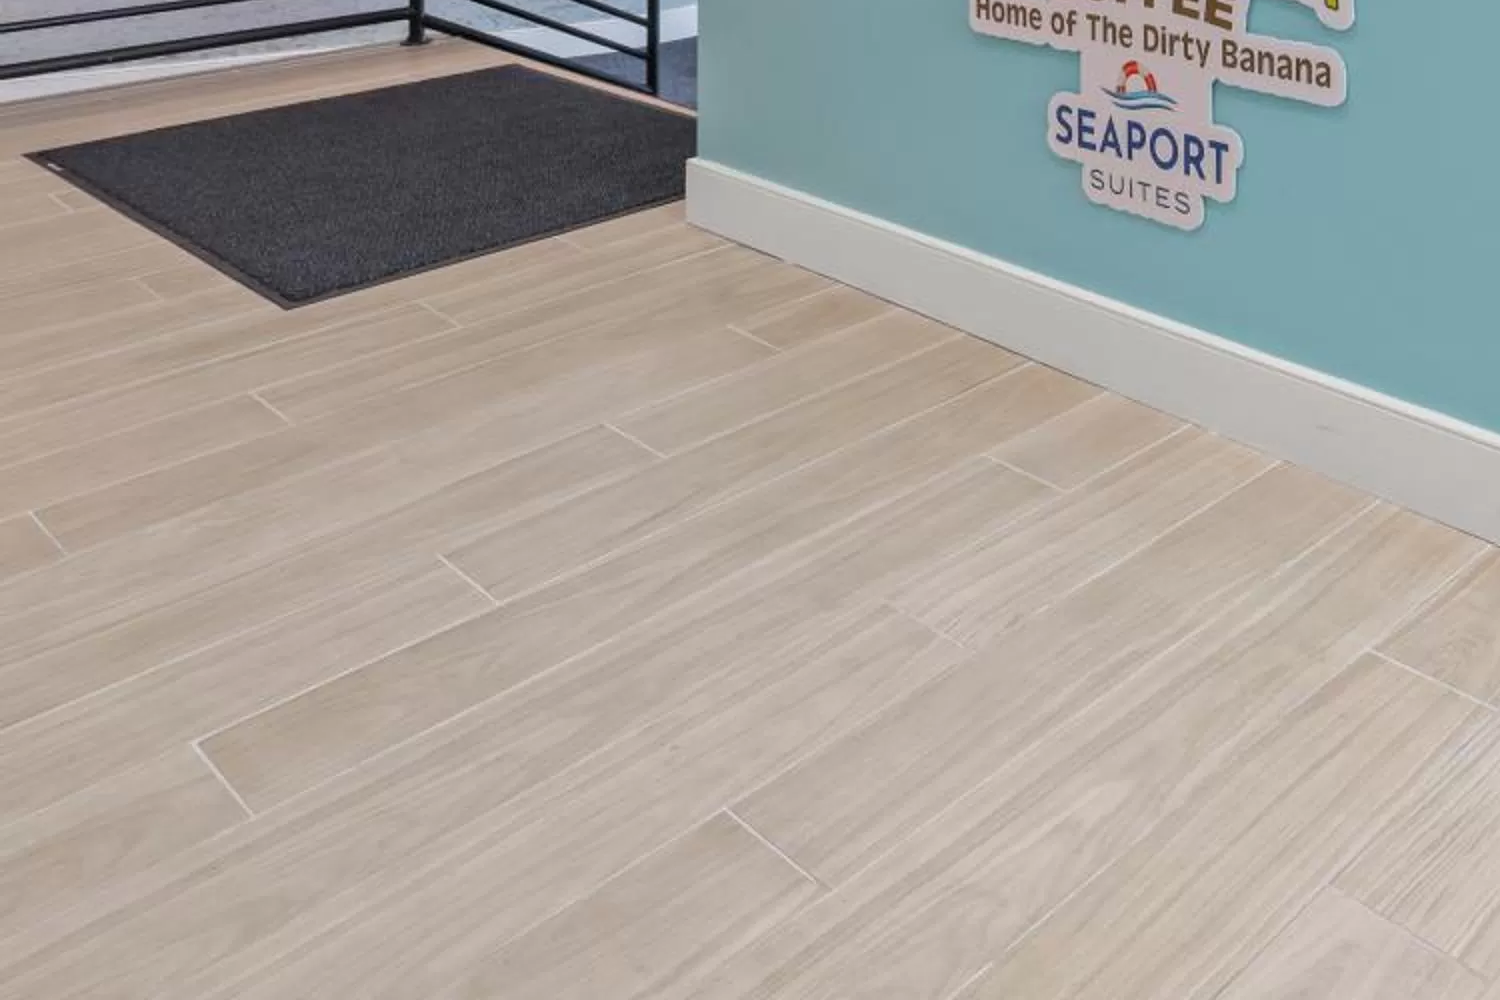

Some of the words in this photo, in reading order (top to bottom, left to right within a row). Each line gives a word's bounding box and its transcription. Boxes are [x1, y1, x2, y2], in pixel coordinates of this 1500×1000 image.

[1051, 10, 1077, 37] of
[1086, 14, 1133, 48] The
[1143, 23, 1210, 68] Dirty
[1221, 40, 1332, 88] Banana
[1055, 104, 1229, 184] SEAPORT
[1090, 169, 1191, 215] SUITES
